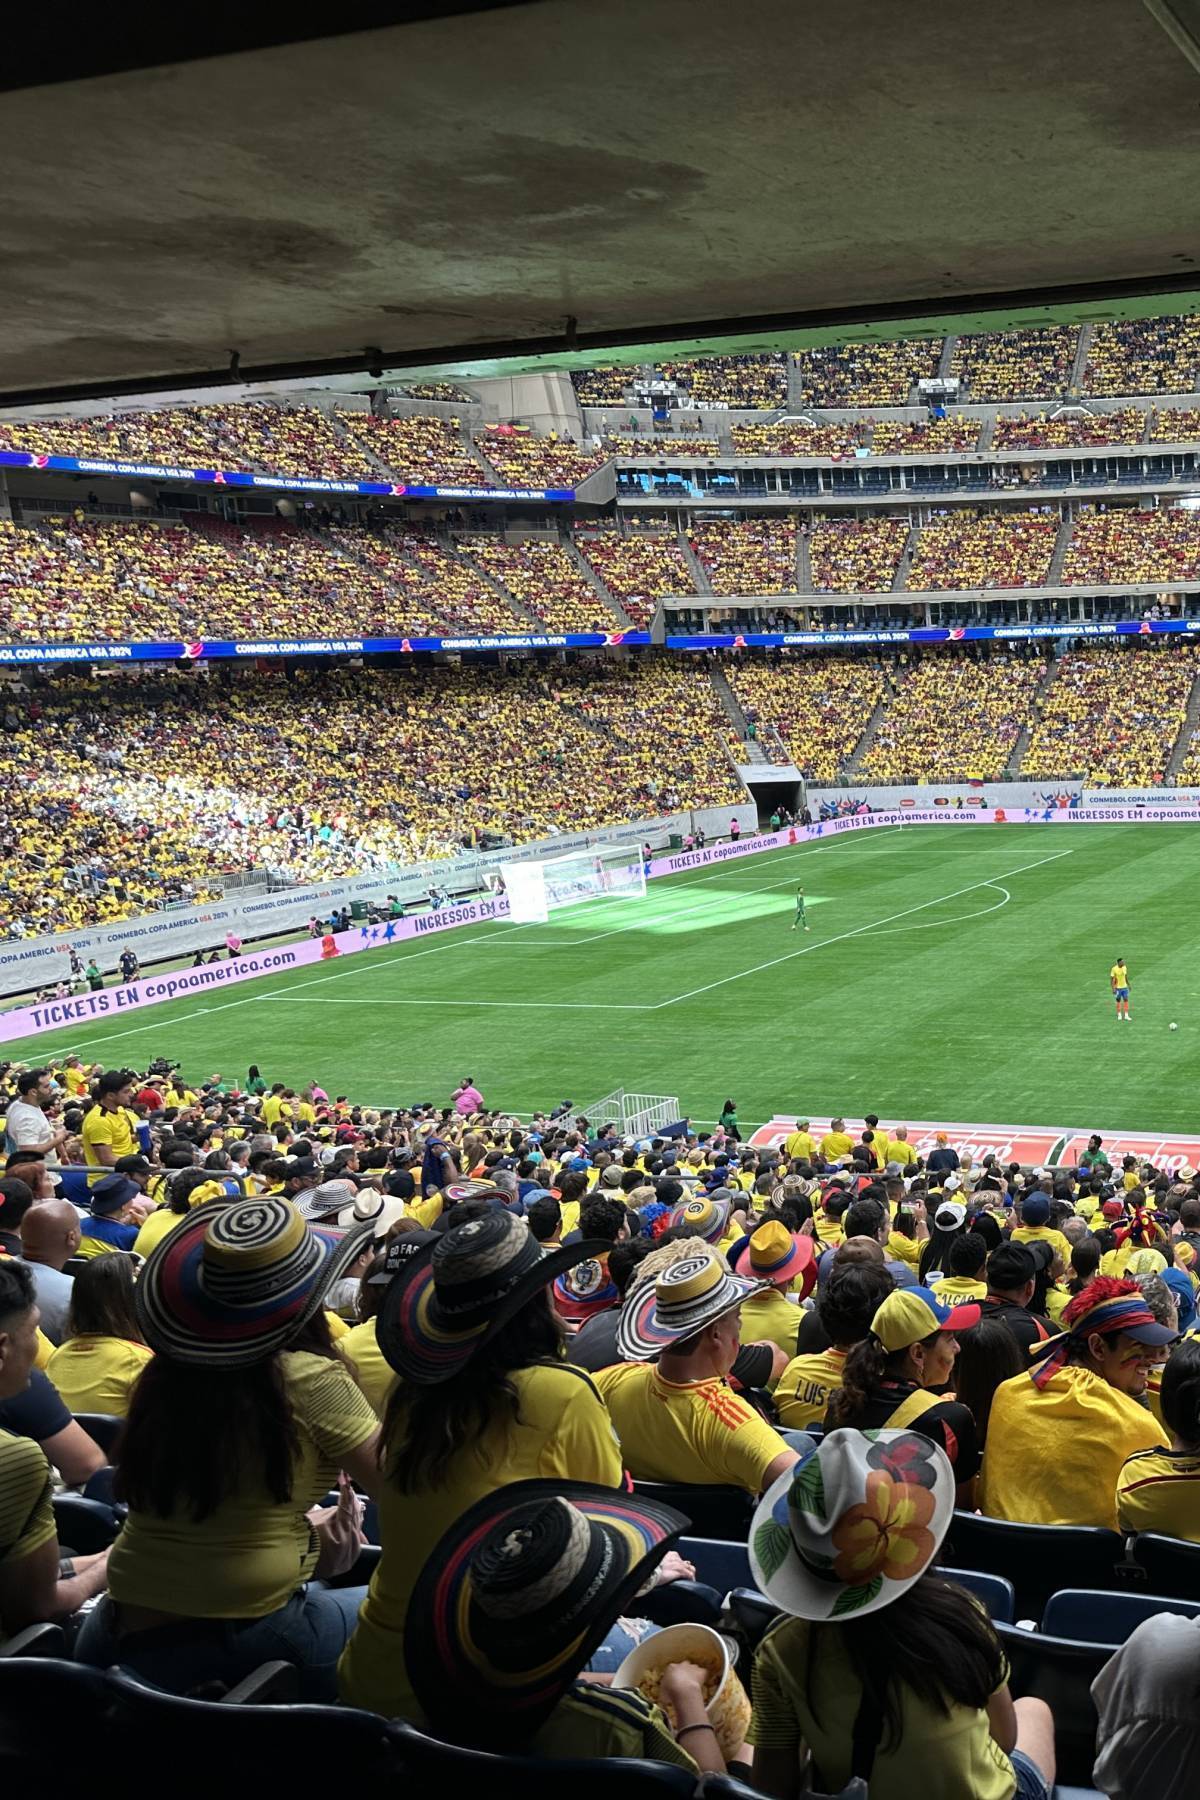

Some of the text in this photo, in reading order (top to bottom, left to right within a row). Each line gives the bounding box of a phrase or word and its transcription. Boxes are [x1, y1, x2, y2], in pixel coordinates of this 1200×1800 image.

[16, 649, 44, 659] COPA
[44, 648, 88, 658] AMERICA
[89, 648, 108, 657] USA
[108, 647, 132, 657] 2024
[280, 643, 299, 652] COPA
[300, 643, 331, 652] AMERICA
[482, 639, 500, 647] COPA
[500, 638, 532, 646] AMERICA
[834, 812, 976, 830] TICKETS EN copaamerica.com
[1068, 810, 1124, 819] INGRESSOS
[1128, 810, 1142, 819] EM
[669, 837, 777, 870] TICKETS AT copaamerica.com
[242, 903, 275, 914] CONMEBOL
[276, 898, 292, 906] COPA
[293, 894, 318, 903] AMERICA
[331, 888, 344, 896] 2024
[107, 928, 146, 942] CONMEBOL
[149, 924, 168, 933] COPA
[169, 917, 198, 930] AMERICA
[213, 911, 228, 920] 2024
[415, 907, 476, 932] INGRESSOS
[19, 947, 55, 961] AMERICA
[56, 944, 71, 952] USA
[73, 940, 91, 949] 2024
[30, 949, 296, 1028] TICKETS EN copaamerica.com
[794, 1380, 827, 1406] LUIS
